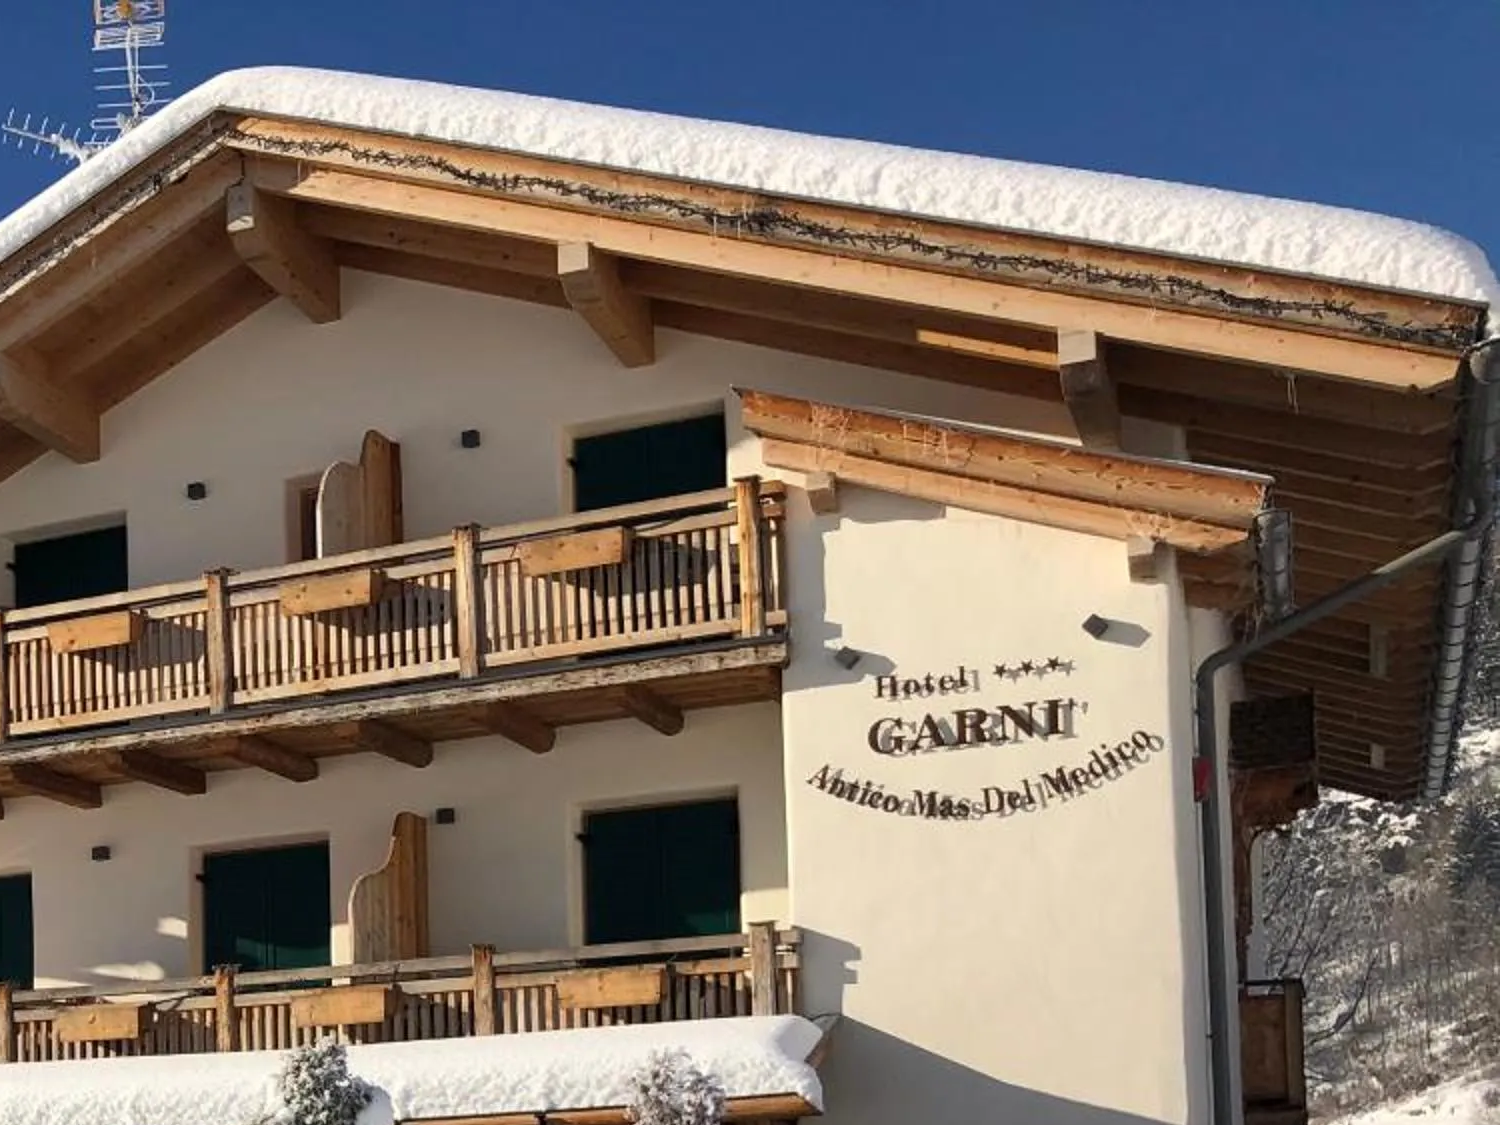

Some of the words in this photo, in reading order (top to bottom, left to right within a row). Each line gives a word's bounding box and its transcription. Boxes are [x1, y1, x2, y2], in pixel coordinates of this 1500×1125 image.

[874, 666, 969, 698] Hotel
[806, 763, 903, 813] Antico
[910, 788, 971, 818] Mas
[981, 779, 1036, 815] Del
[1040, 729, 1151, 801] Medico
